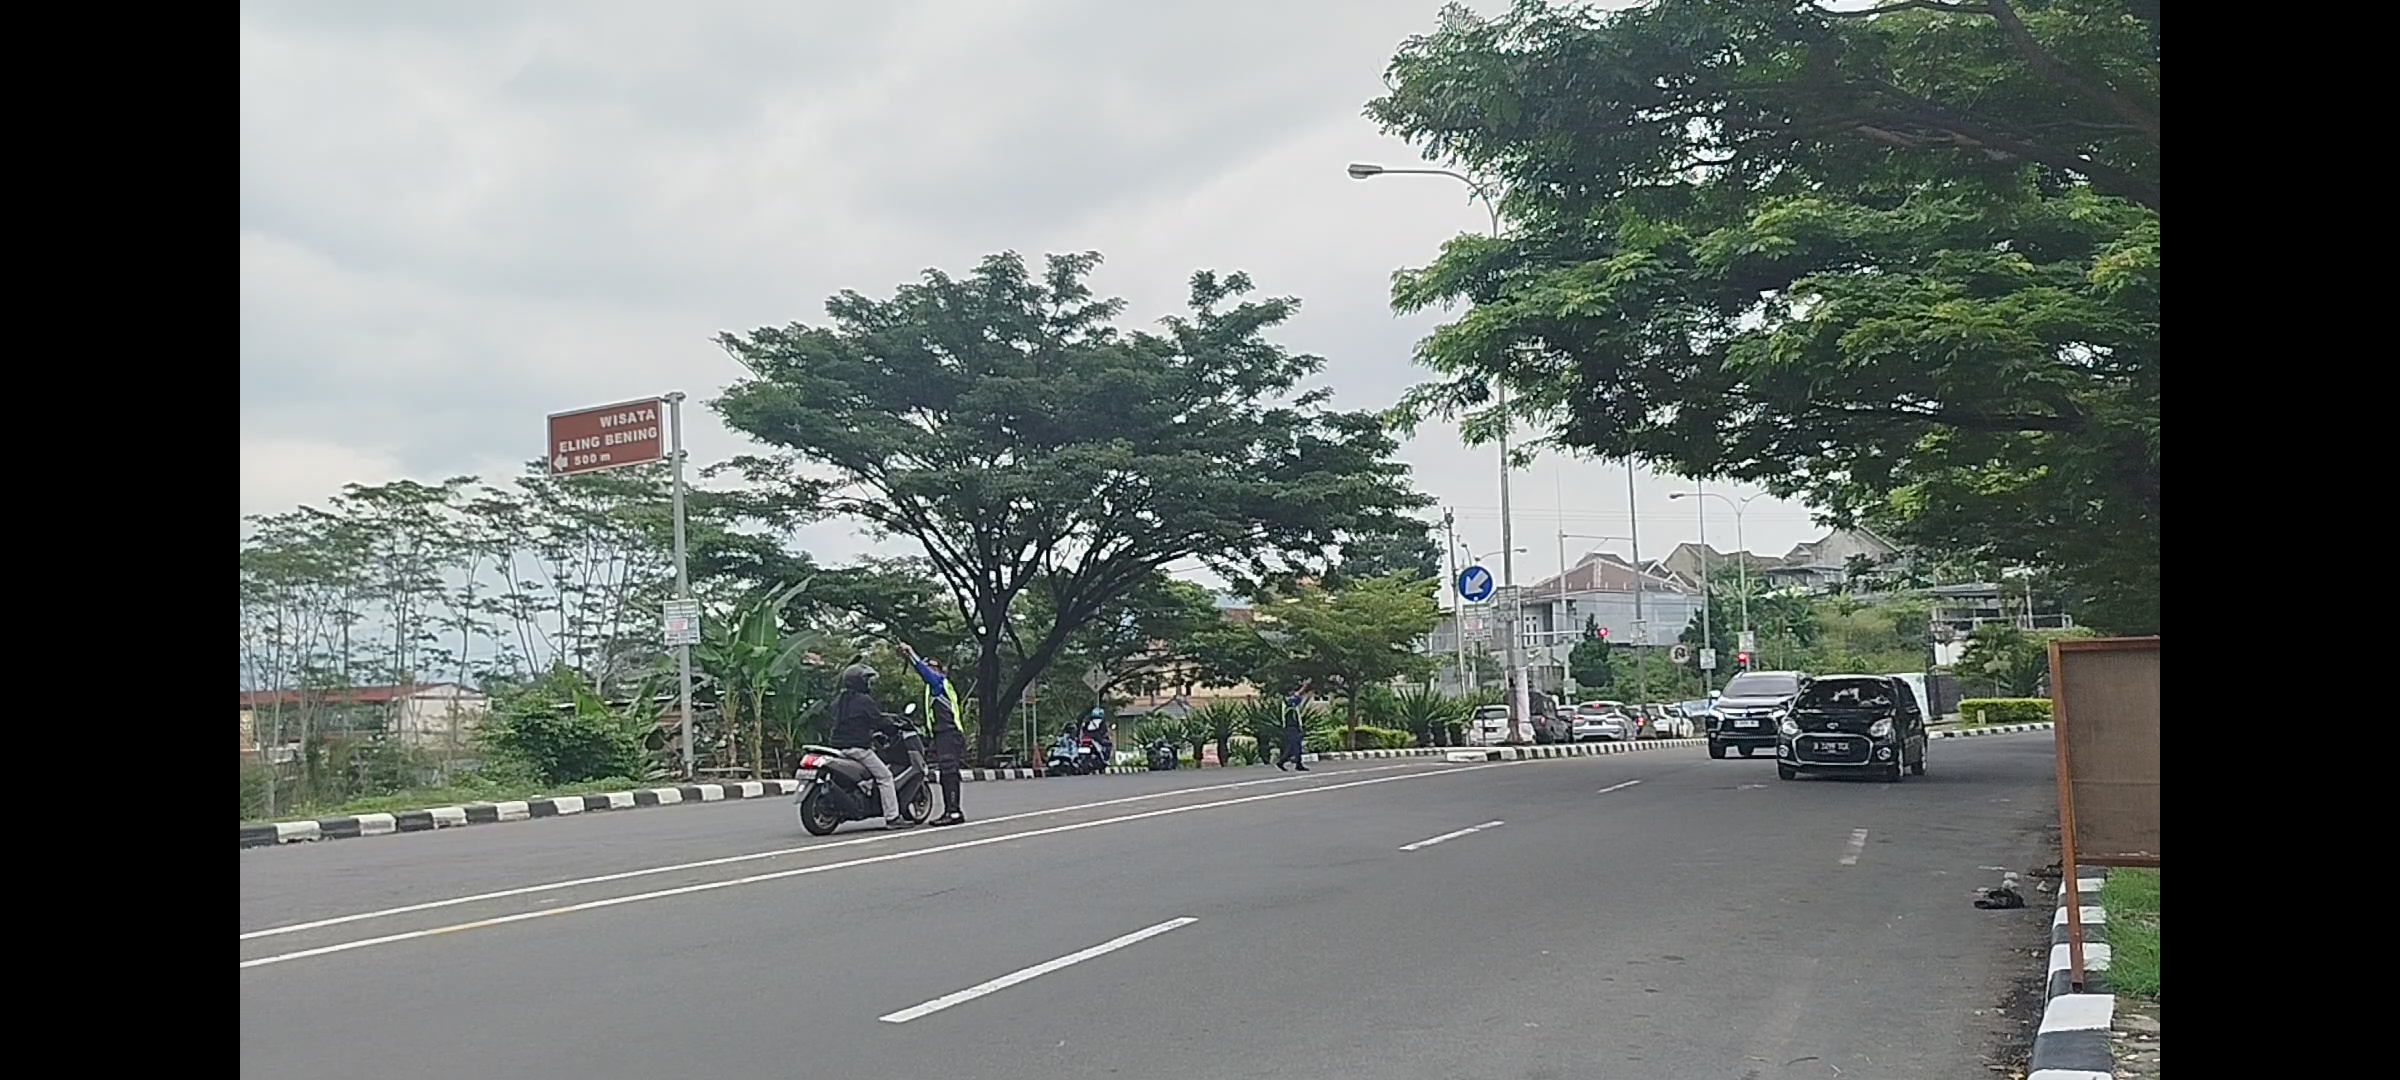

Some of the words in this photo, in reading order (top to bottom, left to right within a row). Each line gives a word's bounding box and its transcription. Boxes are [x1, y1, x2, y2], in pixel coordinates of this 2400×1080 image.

[600, 408, 656, 428] WISATA
[559, 436, 600, 453] ELING
[605, 426, 658, 446] BENING
[574, 453, 597, 466] 500
[600, 452, 611, 462] m
